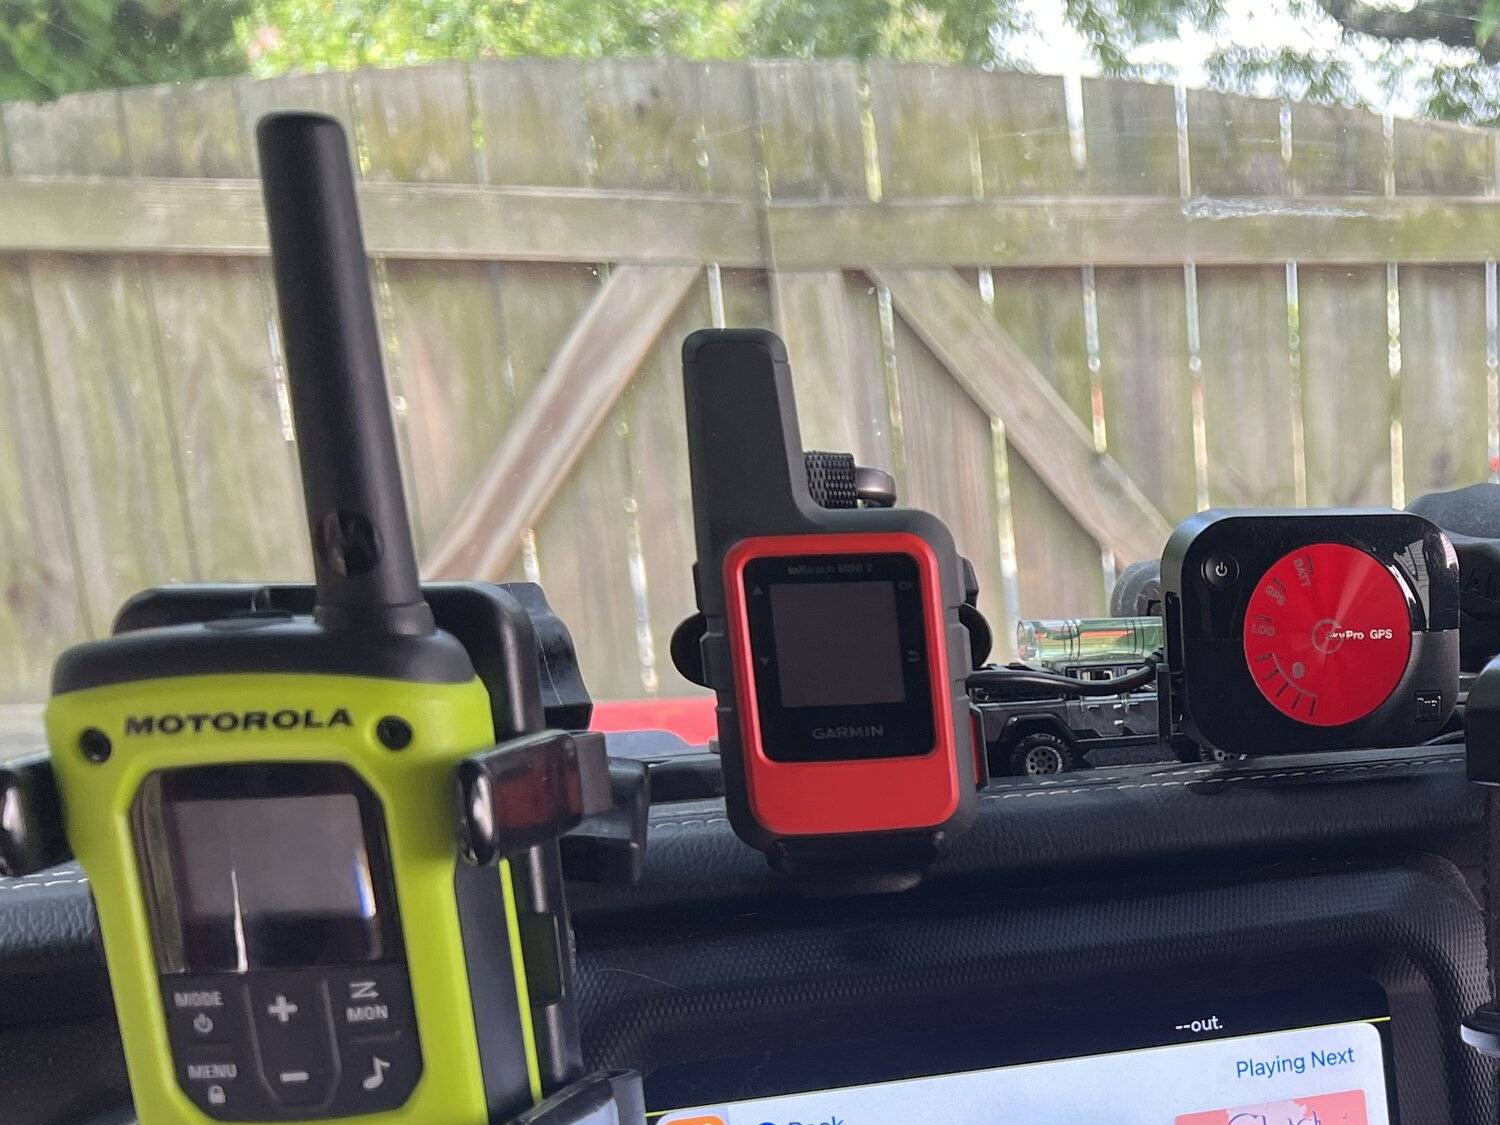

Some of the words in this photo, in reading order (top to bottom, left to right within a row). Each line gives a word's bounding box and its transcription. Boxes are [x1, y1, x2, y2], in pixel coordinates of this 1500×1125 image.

[1370, 629, 1393, 640] GPS
[125, 708, 354, 738] MOTOROLA
[812, 725, 884, 740] GARMIN
[174, 991, 224, 1008] MODE
[346, 1003, 389, 1022] MON
[1236, 1054, 1306, 1078] Playing
[1310, 1047, 1355, 1069] Next
[187, 1063, 238, 1081] MENU
